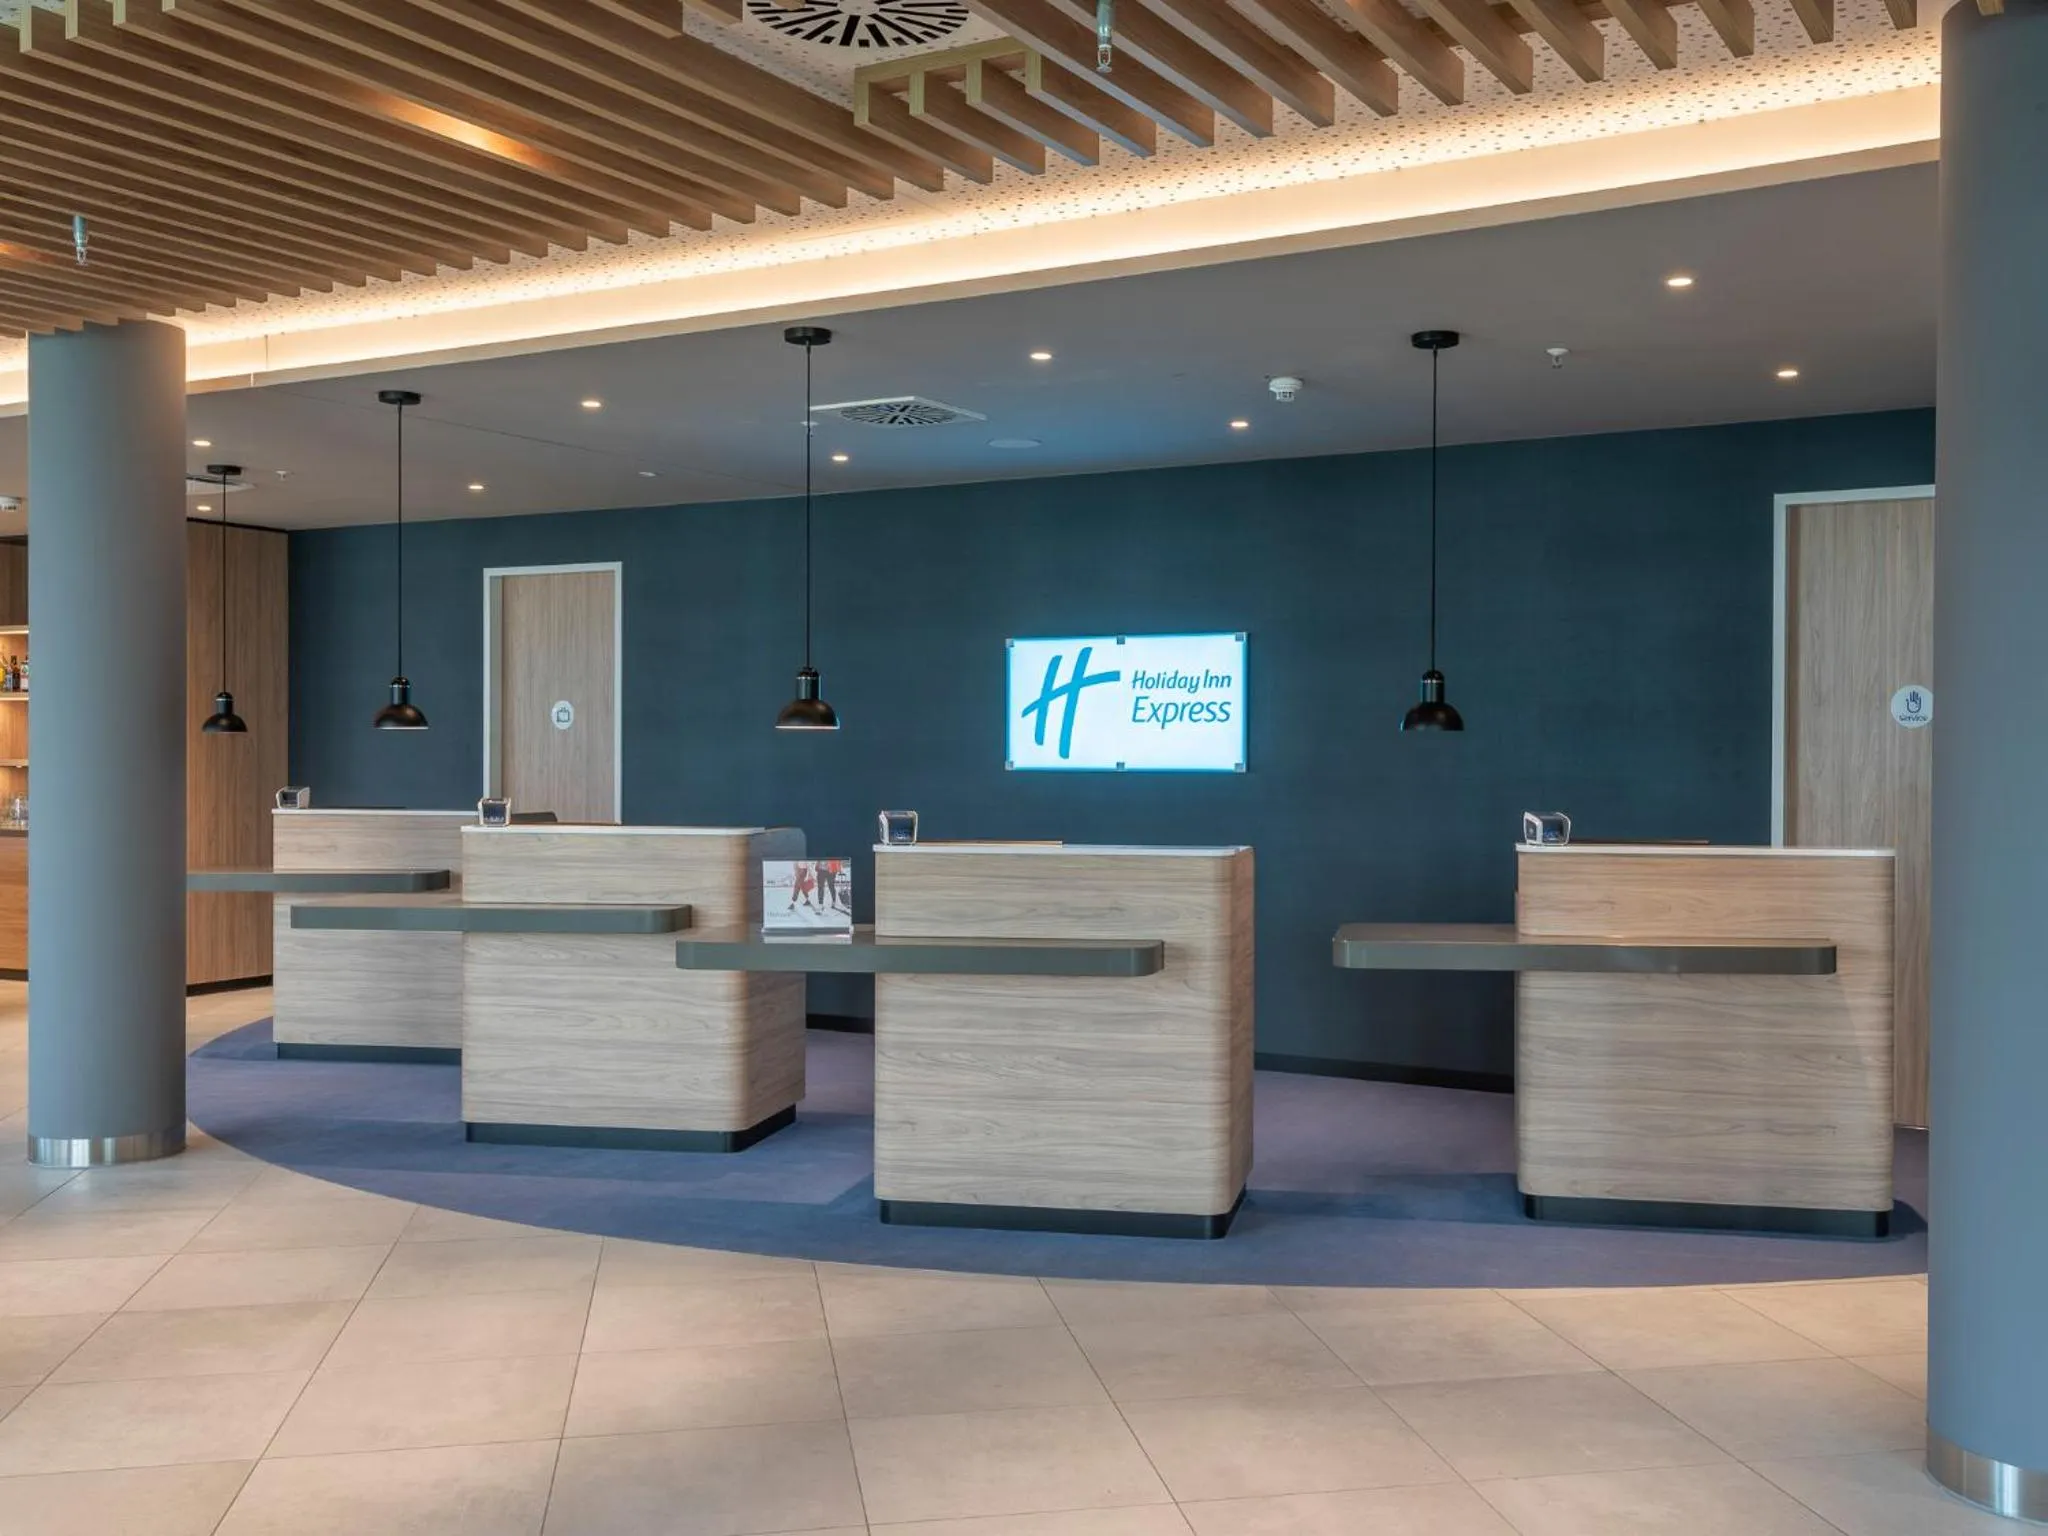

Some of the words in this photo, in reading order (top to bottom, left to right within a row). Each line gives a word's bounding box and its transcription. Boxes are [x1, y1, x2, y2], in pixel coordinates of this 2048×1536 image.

[1131, 669, 1200, 694] Holiday
[1202, 669, 1233, 689] Inn
[1131, 696, 1232, 730] Express
